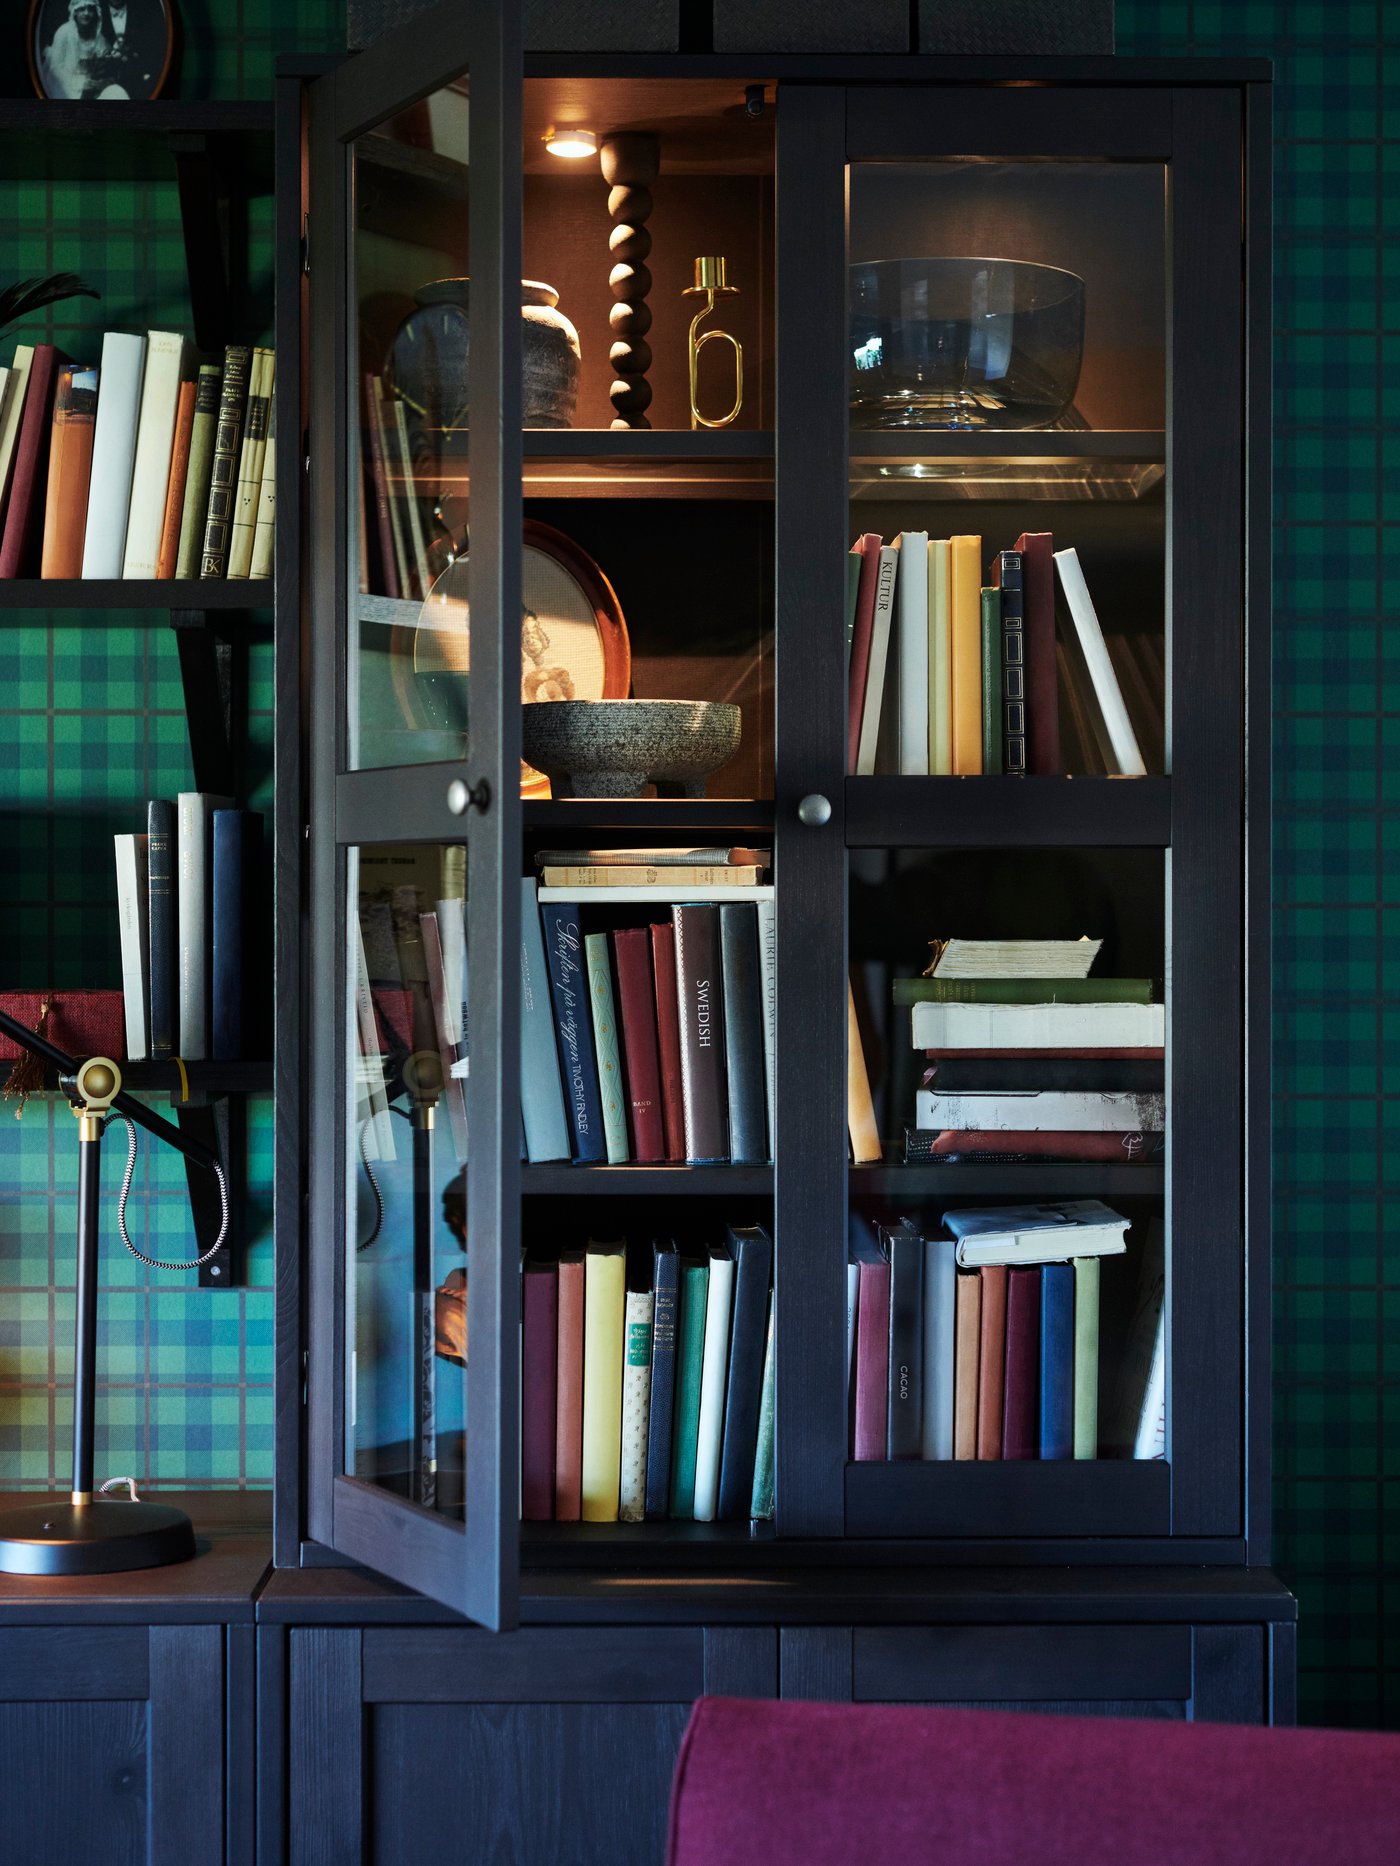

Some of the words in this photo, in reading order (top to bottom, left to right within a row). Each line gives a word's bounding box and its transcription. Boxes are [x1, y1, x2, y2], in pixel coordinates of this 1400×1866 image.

[204, 557, 220, 573] BK
[877, 561, 893, 612] KULTUR
[556, 919, 580, 984] Skriften
[765, 917, 775, 971] LAURIE
[556, 982, 577, 1007] på
[696, 980, 711, 1048] SWEDISH
[560, 1009, 582, 1063] väggen
[572, 1064, 585, 1102] TIMOTHY
[575, 1102, 589, 1136] FINDLEY
[900, 1365, 908, 1399] CACAO
